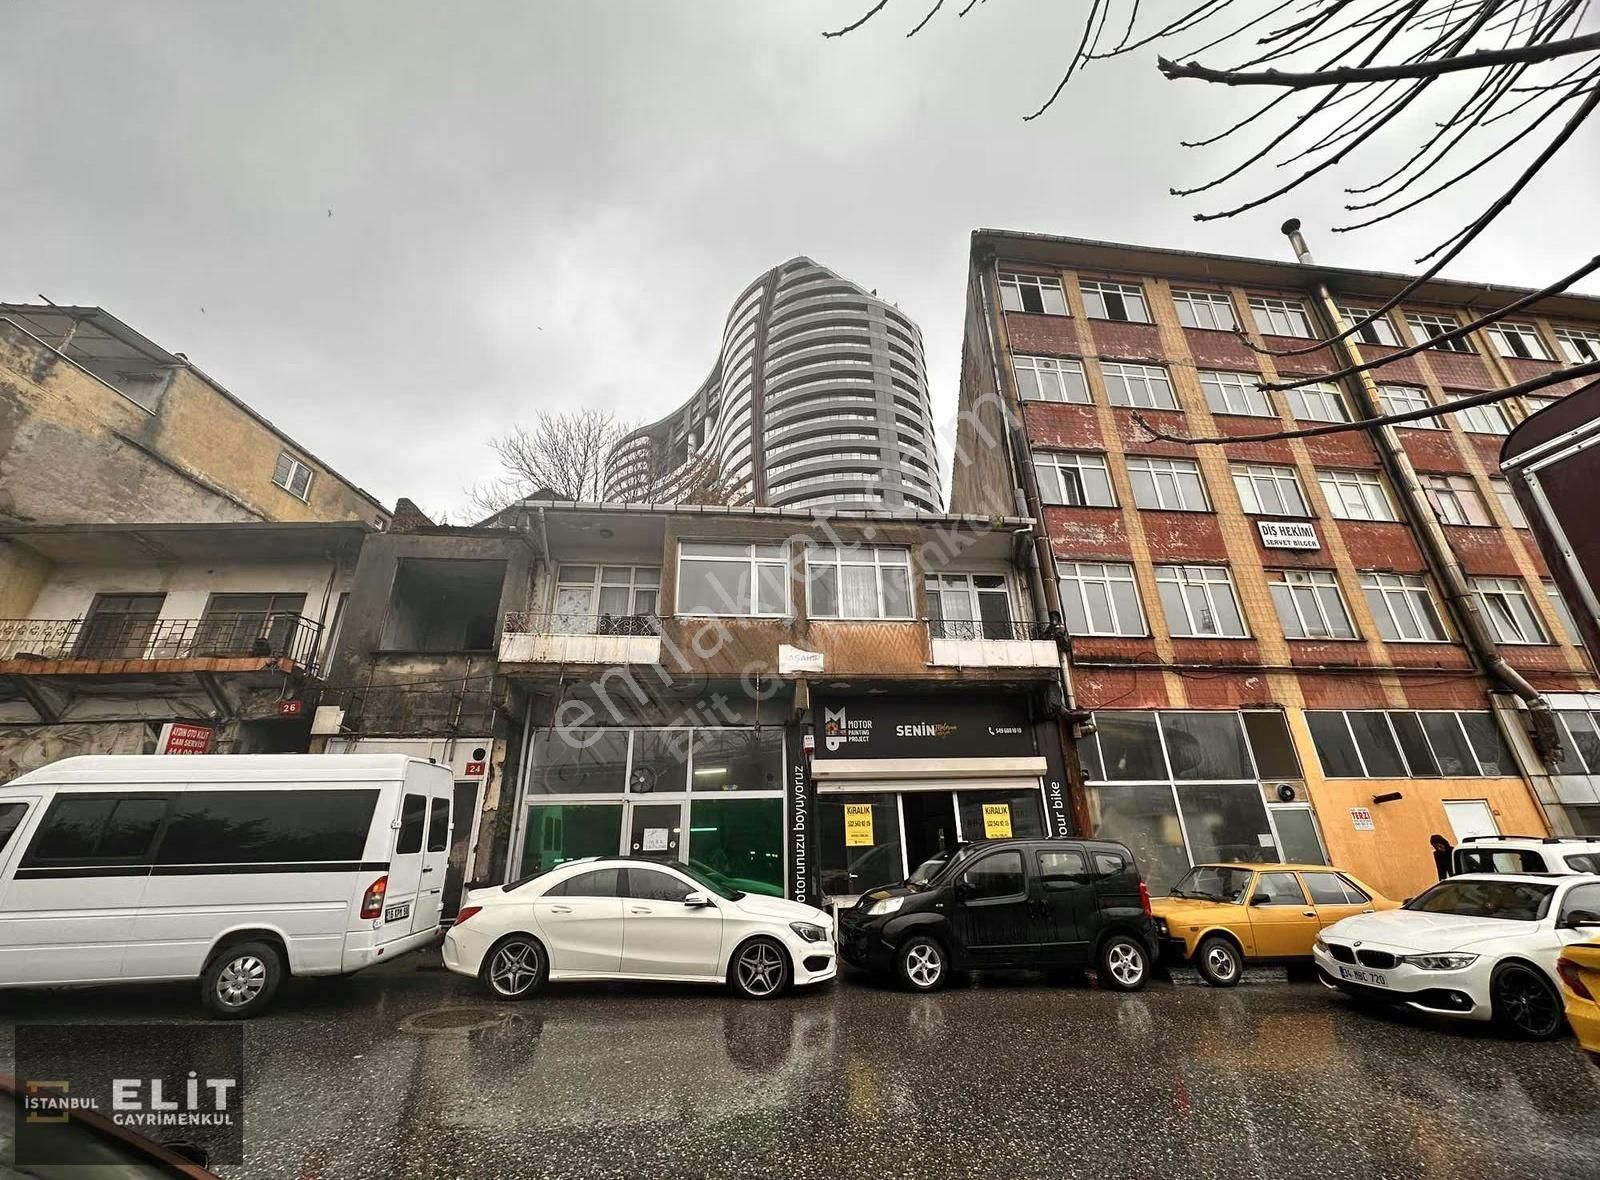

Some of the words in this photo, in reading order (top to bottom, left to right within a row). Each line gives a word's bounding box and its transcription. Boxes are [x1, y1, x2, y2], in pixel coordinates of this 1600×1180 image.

[1261, 523, 1278, 537] DİŞ
[1278, 524, 1314, 538] HEKİMİ
[283, 703, 296, 712] 26
[848, 720, 873, 729] MOTOR
[896, 722, 936, 737] SENİN
[469, 765, 481, 773] 24
[793, 765, 807, 831] boyuyoruz
[1050, 781, 1064, 809] bike
[1055, 811, 1068, 838] our
[795, 833, 806, 903] otorunuzu
[1369, 973, 1386, 985] 720
